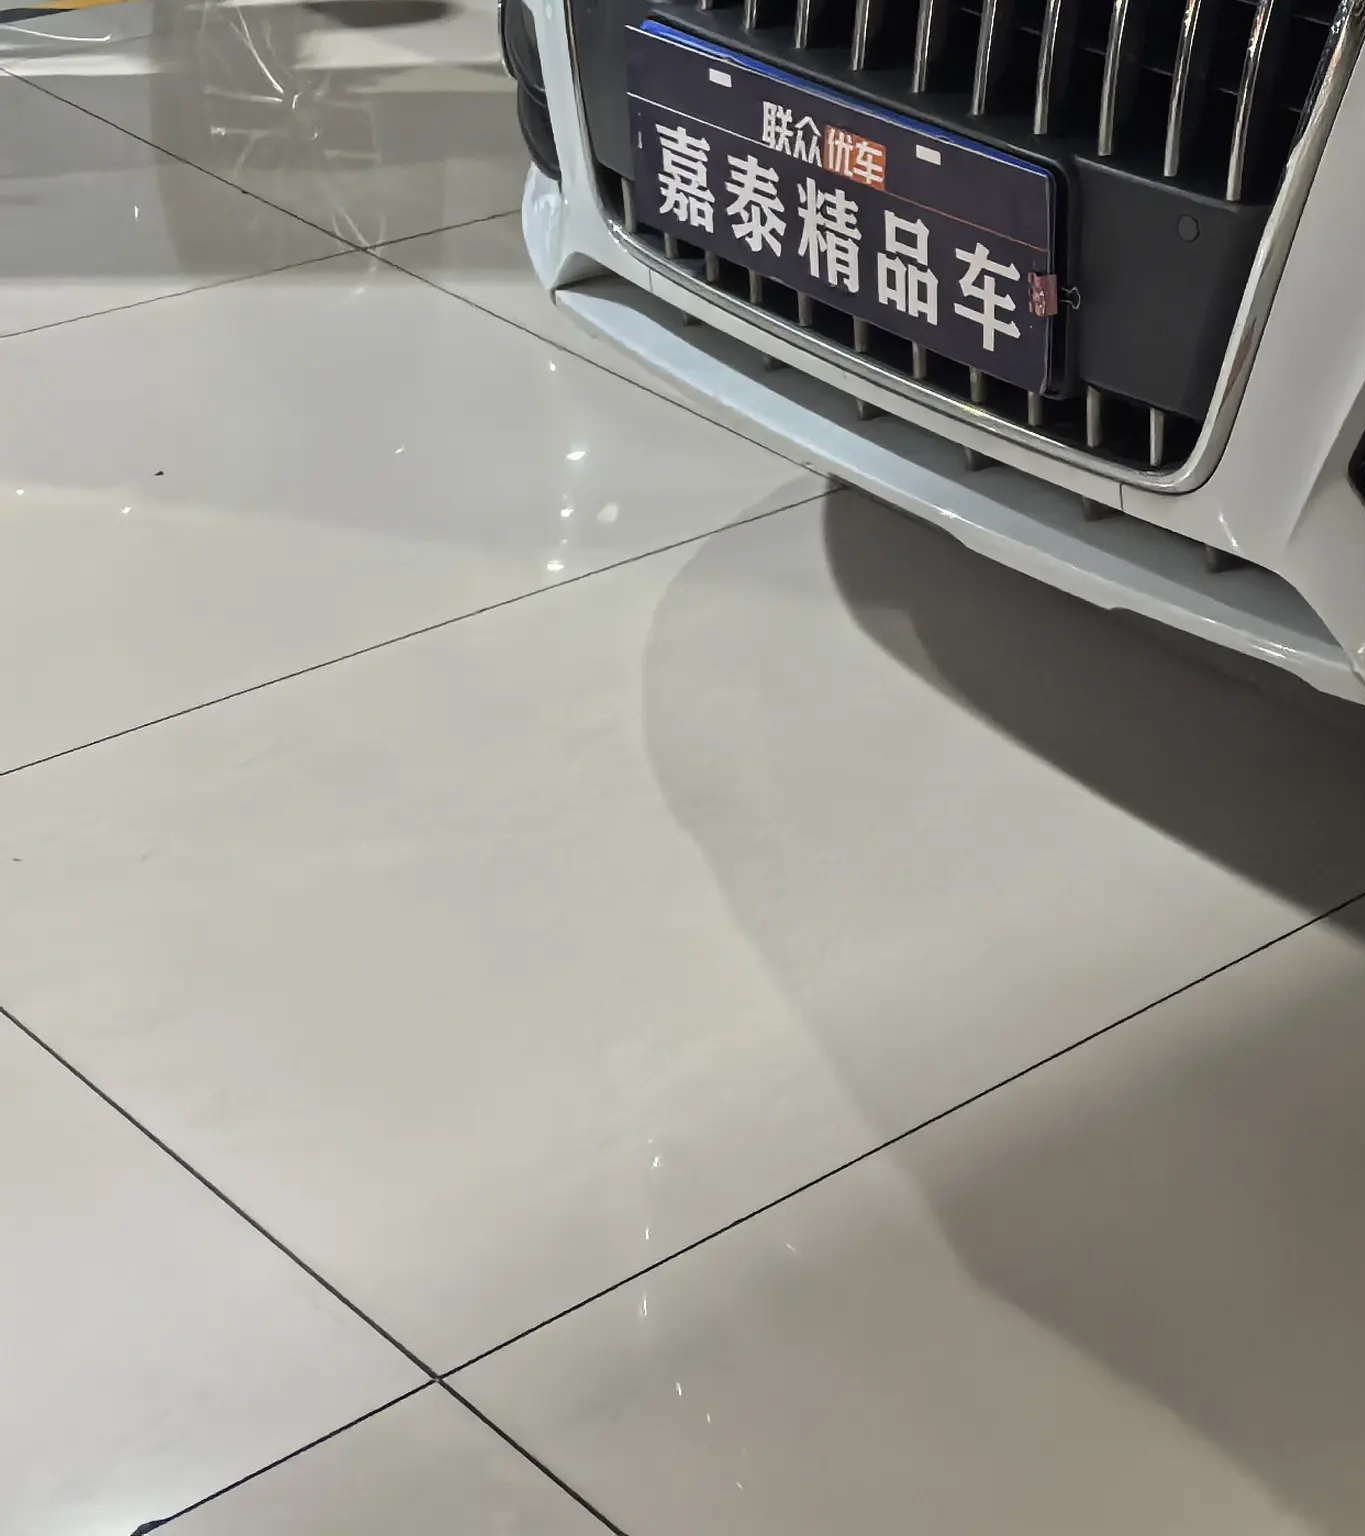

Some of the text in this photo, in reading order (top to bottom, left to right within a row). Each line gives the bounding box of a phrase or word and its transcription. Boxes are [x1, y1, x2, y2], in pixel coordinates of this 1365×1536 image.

[762, 100, 886, 186] 联众优车
[656, 124, 1022, 352] 嘉泰精品车
